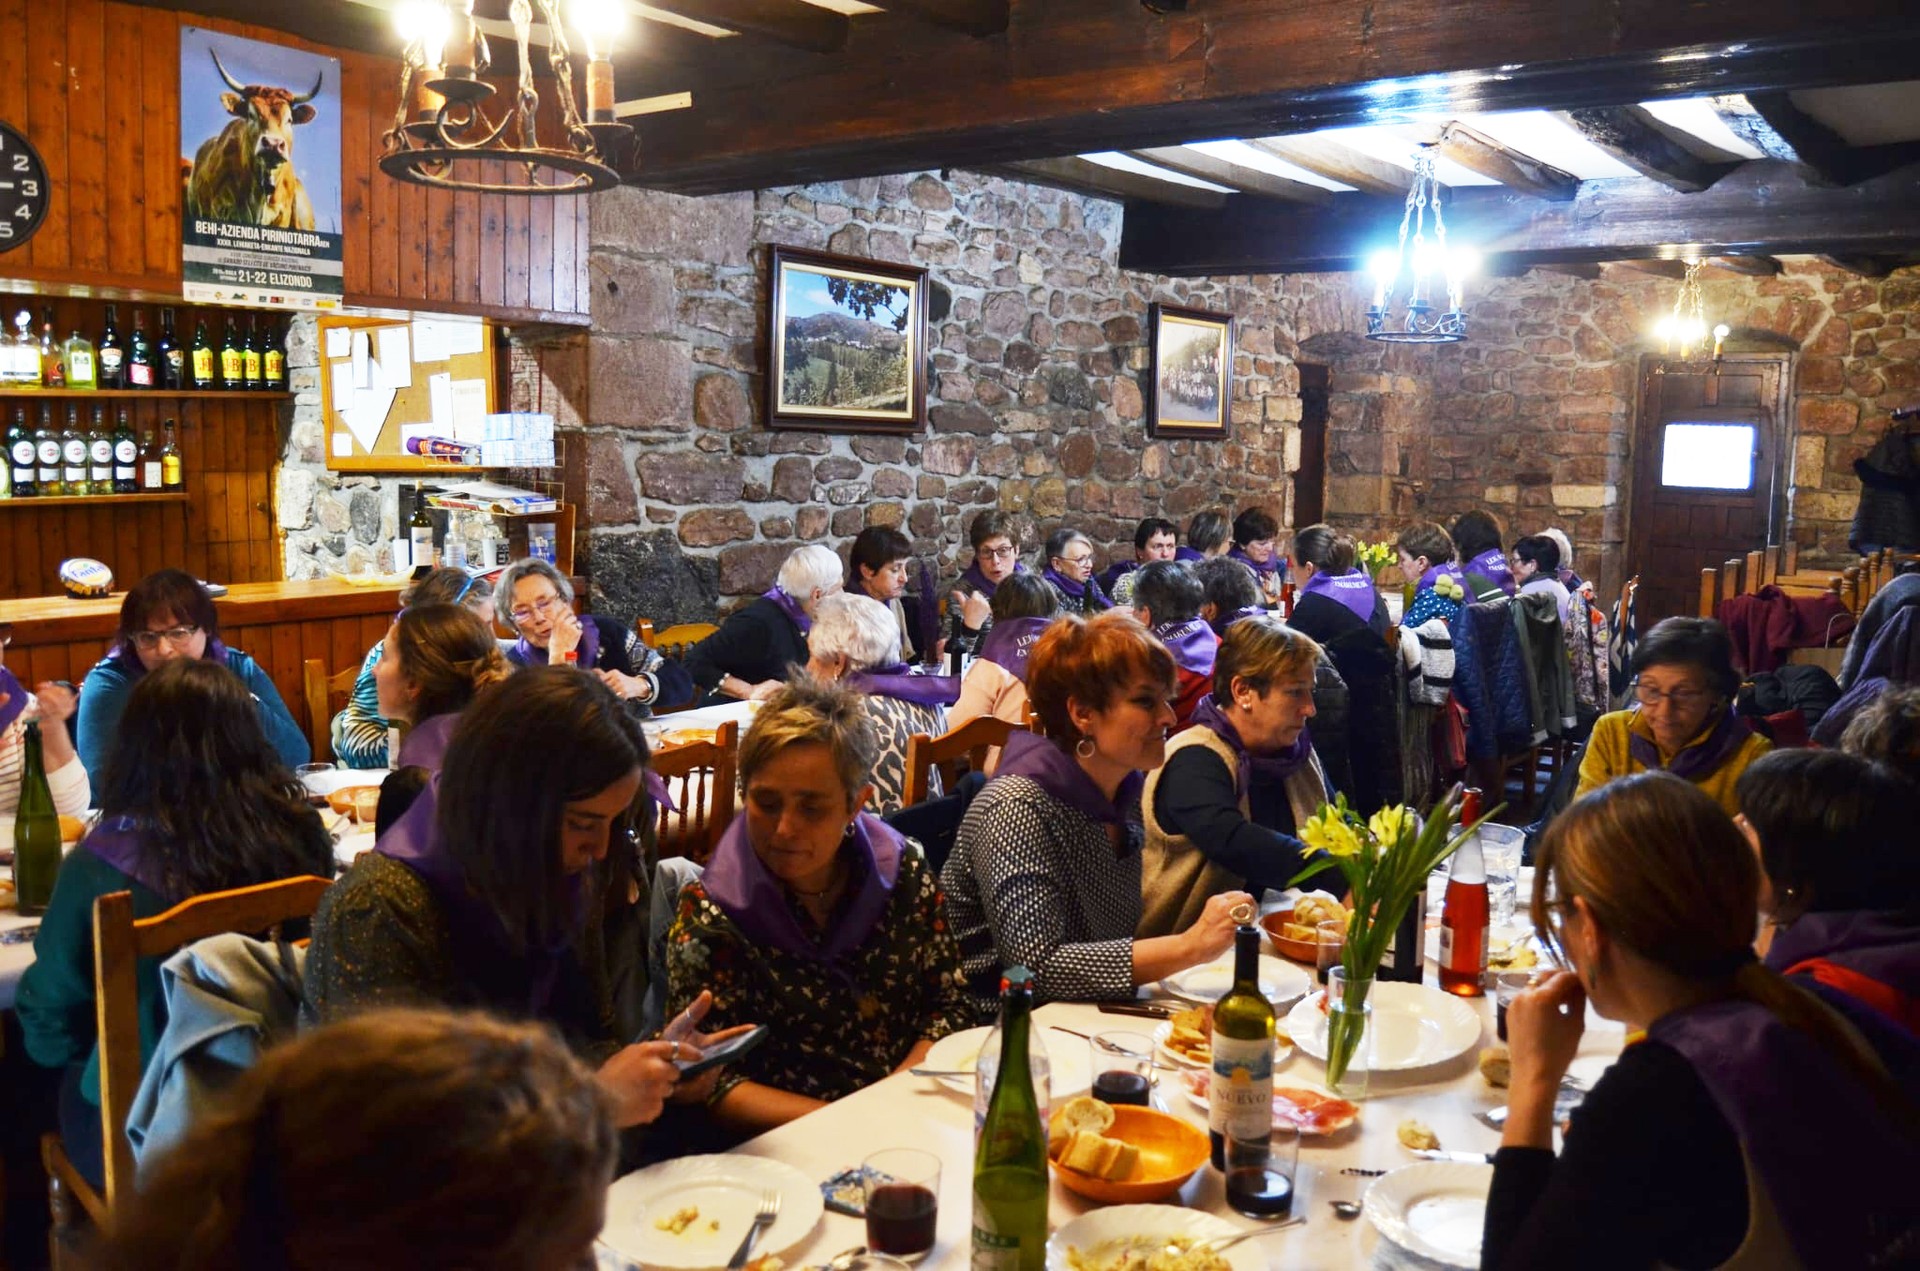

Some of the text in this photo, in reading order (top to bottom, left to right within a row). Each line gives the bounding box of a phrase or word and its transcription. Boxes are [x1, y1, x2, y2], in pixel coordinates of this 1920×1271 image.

[13, 154, 30, 172] 2
[22, 180, 38, 197] 3
[15, 204, 32, 220] 4
[0, 221, 14, 238] 5
[195, 220, 260, 241] BEHI-AZIENDA
[238, 269, 267, 284] 21-22
[269, 272, 313, 289] ELIZONDO
